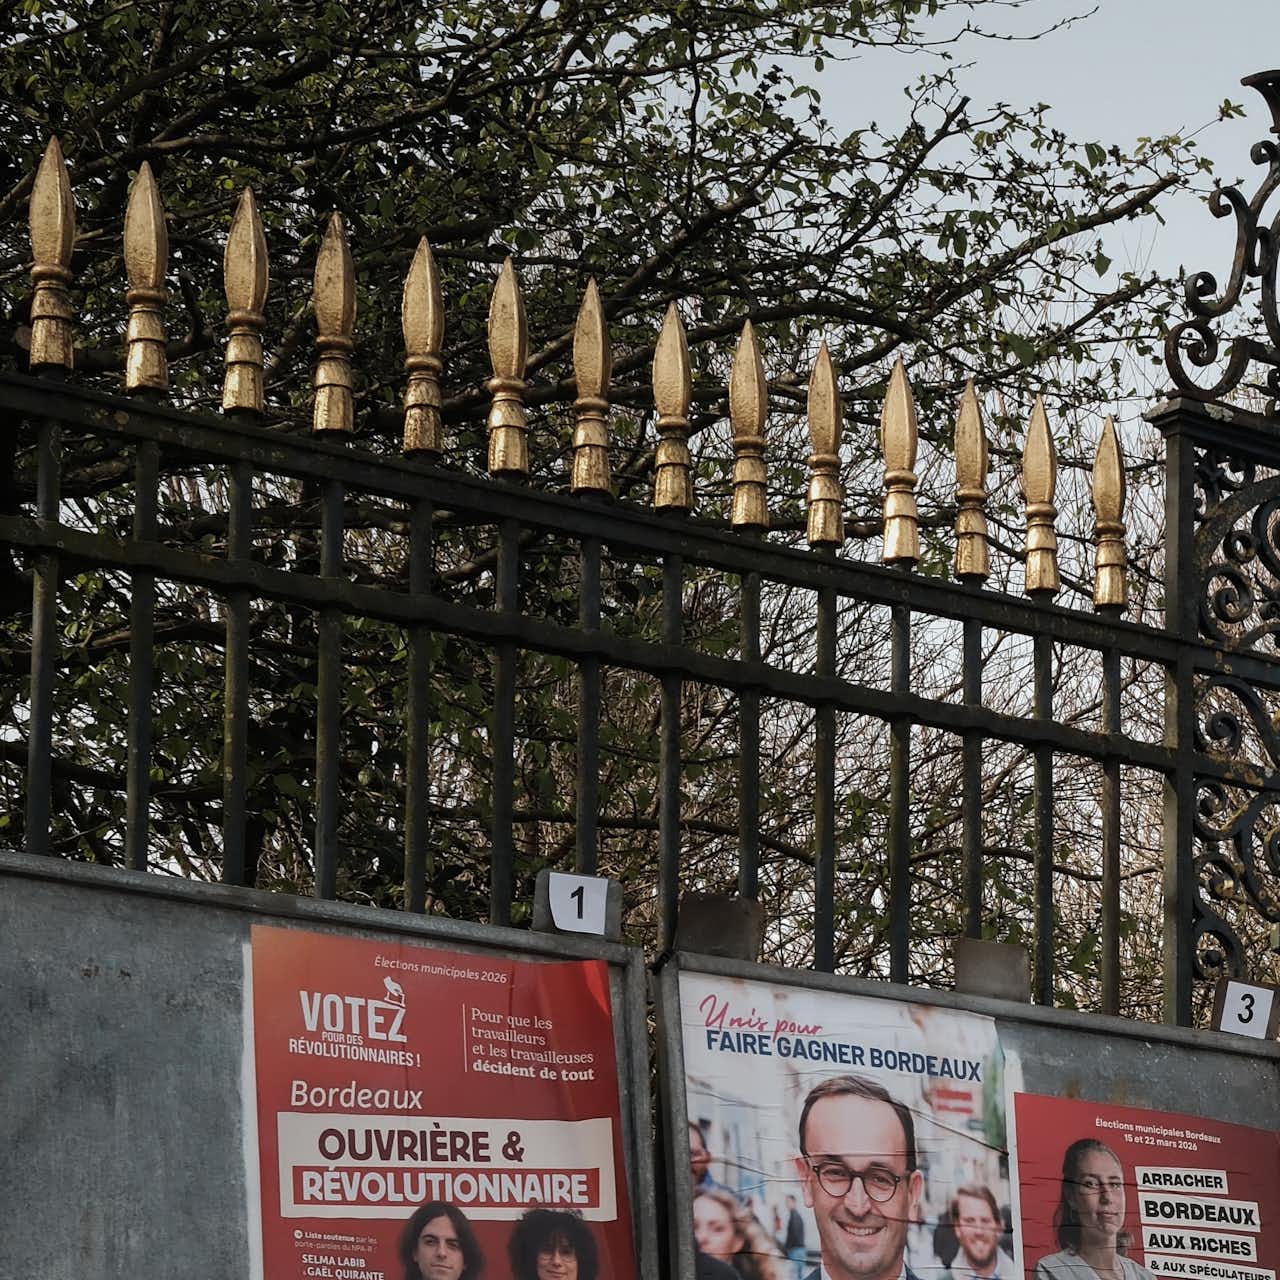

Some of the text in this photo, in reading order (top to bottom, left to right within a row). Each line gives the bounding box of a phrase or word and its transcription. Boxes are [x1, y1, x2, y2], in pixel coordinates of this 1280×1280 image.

[569, 886, 585, 920] 1
[374, 956, 508, 984] Élections municipales 2026
[299, 989, 408, 1043] VOTEZ
[471, 1007, 553, 1030] Pour que les
[699, 994, 823, 1041] Unis pour
[1237, 993, 1256, 1024] 3
[321, 1031, 364, 1046] POUR DES
[471, 1026, 546, 1046] travailleurs
[472, 1044, 594, 1064] et les travailleuses
[706, 1029, 982, 1082] FAIRE GAGNER BORDEAUX
[472, 1059, 595, 1081] décident de tout
[290, 1080, 423, 1109] Bordeaux
[318, 1122, 525, 1162] OUVRIÈRE &
[1095, 1117, 1222, 1143] Élections municipales Bordeaux
[302, 1165, 589, 1204] RÉVOLUTIONNAIRE
[1142, 1172, 1224, 1189] ARRACHER
[1144, 1200, 1256, 1226] BORDEAUX
[1148, 1233, 1251, 1256] AUX RICHES
[302, 1253, 366, 1268] SELMA LABIB
[1150, 1260, 1160, 1270] &
[1162, 1261, 1186, 1273] AUX
